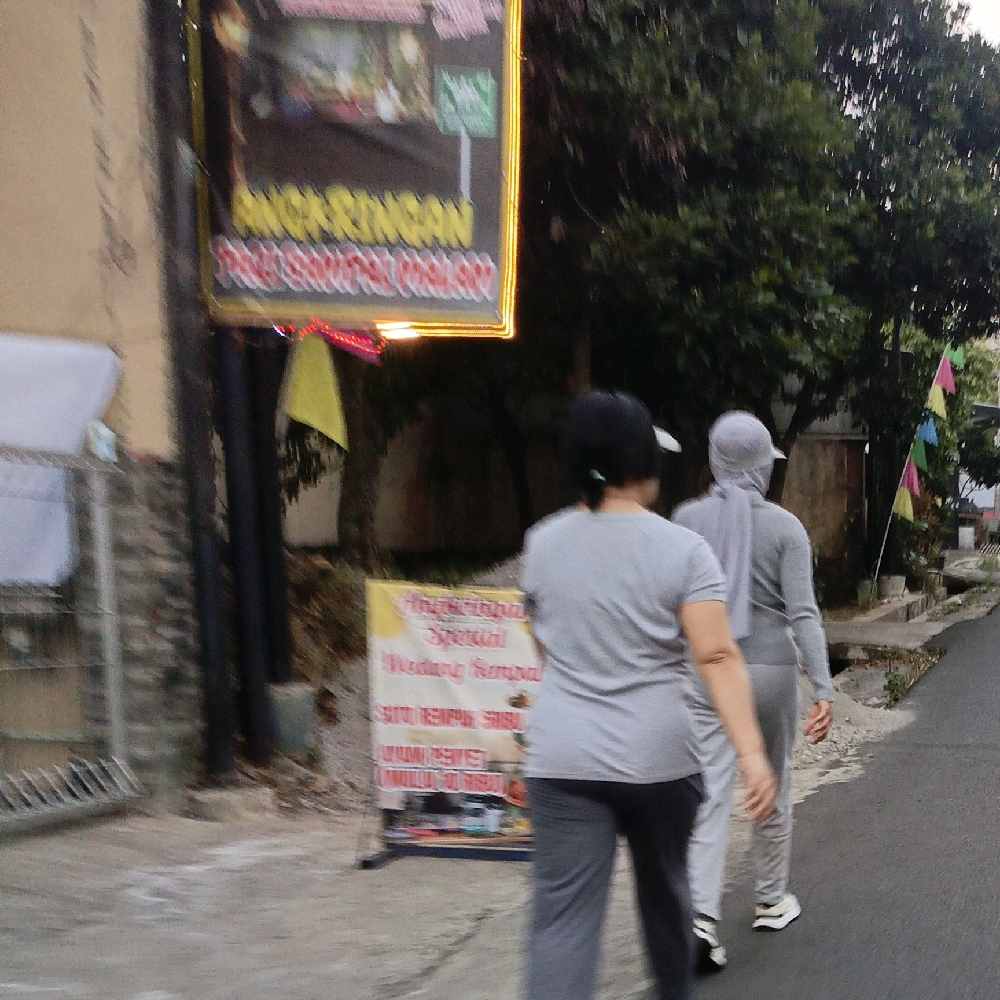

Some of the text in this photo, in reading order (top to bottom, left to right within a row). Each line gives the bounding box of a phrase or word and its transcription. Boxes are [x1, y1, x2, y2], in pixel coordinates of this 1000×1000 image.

[232, 183, 474, 250] ANGKRINGAN
[279, 242, 396, 297] SAMPAI
[390, 248, 496, 302] MALAM
